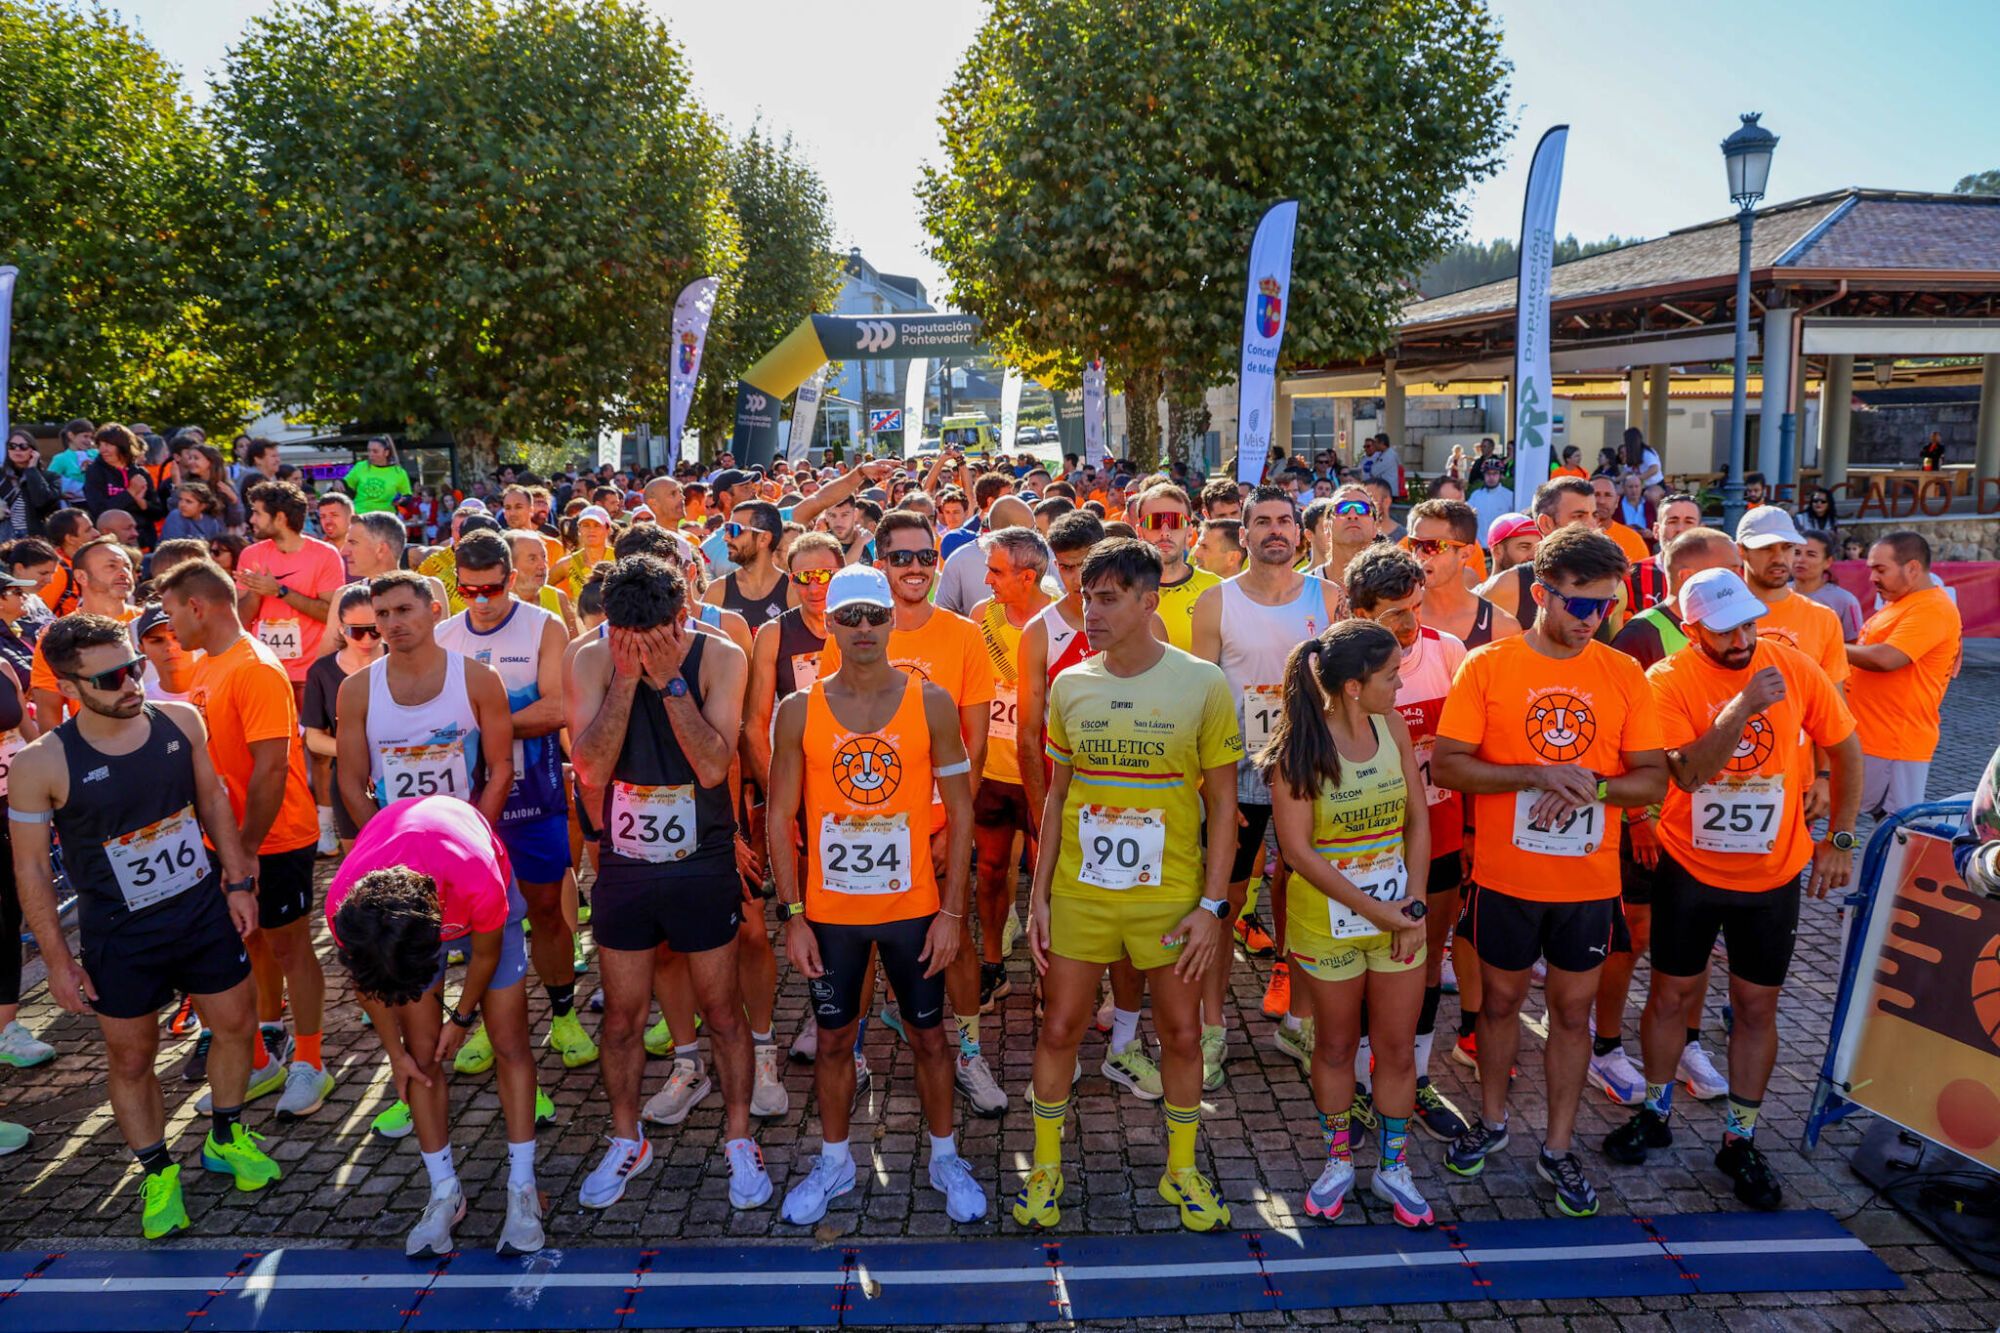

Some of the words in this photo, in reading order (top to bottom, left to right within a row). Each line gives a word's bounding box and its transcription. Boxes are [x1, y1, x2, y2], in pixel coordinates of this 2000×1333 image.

[1524, 228, 1543, 362] Deputación
[901, 320, 972, 336] Deputación
[1247, 361, 1257, 373] de
[1243, 432, 1266, 447] Meis
[1763, 478, 1952, 519] ERCADO
[499, 656, 531, 664] DISMAC
[1149, 720, 1175, 729] Lázaro
[1078, 739, 1165, 756] ATHLETICS
[1088, 753, 1109, 766] San
[1112, 754, 1150, 768] Lázaro
[395, 768, 456, 798] 251
[503, 806, 542, 821] BAIONA
[1332, 796, 1406, 824] ATHLETIC
[1703, 803, 1775, 832] 257
[619, 811, 686, 843] 236
[1345, 823, 1365, 833] San
[827, 843, 901, 873] 234
[1093, 836, 1140, 868] 90
[127, 840, 196, 887] 316
